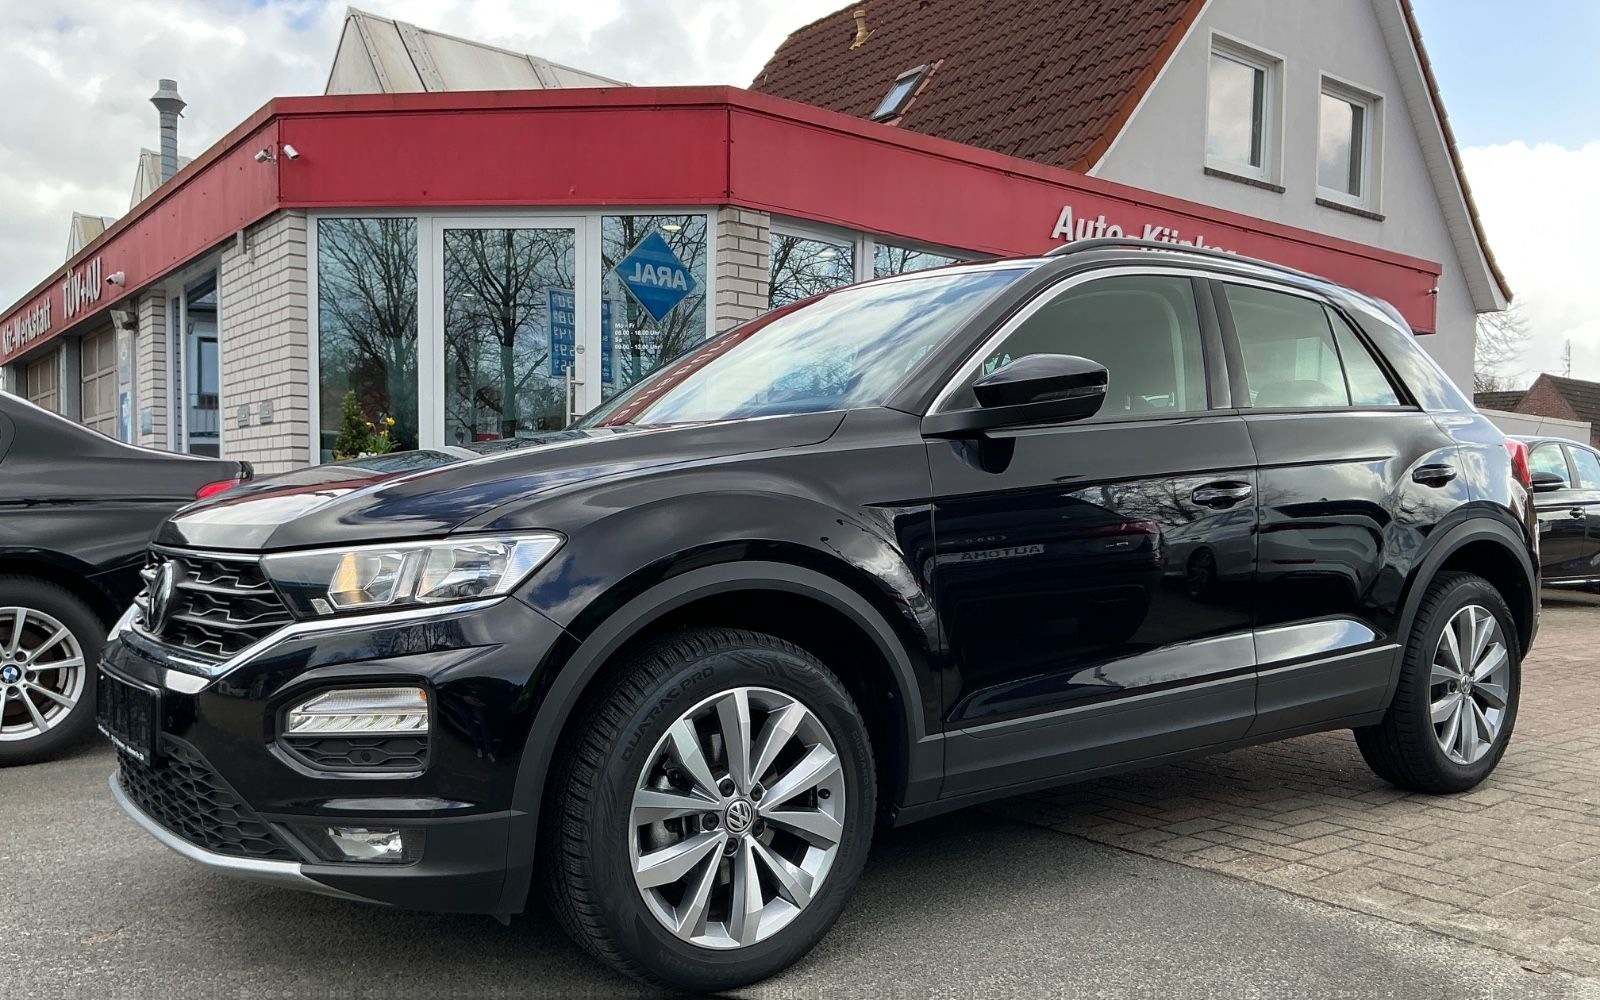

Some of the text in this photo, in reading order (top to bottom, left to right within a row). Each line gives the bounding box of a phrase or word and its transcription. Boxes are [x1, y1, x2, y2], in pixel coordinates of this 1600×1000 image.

[3, 256, 102, 355] Kfz-Werkstatt TÜV+AU
[621, 666, 715, 761] QUATRAC PRO
